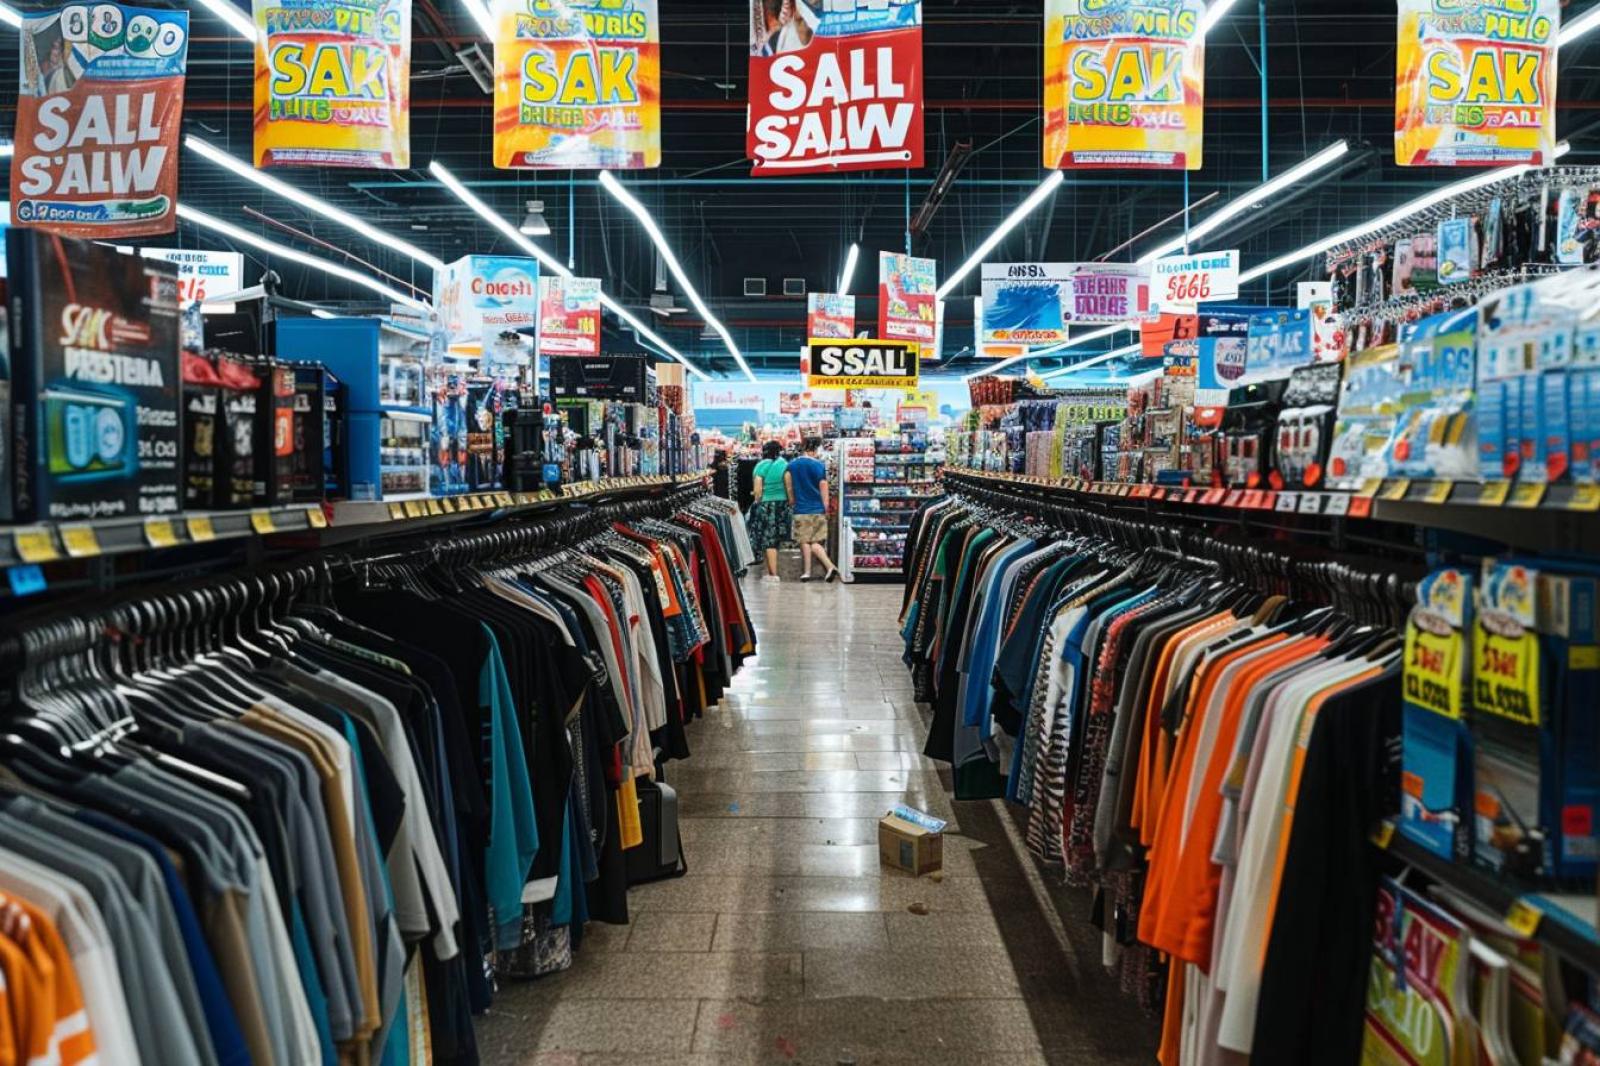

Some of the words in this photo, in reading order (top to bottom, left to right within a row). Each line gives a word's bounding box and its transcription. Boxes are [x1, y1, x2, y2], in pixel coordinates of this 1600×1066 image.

[523, 50, 638, 105] SAK
[768, 47, 905, 111] SALL
[1428, 50, 1540, 104] SAK
[34, 93, 163, 152] SALL
